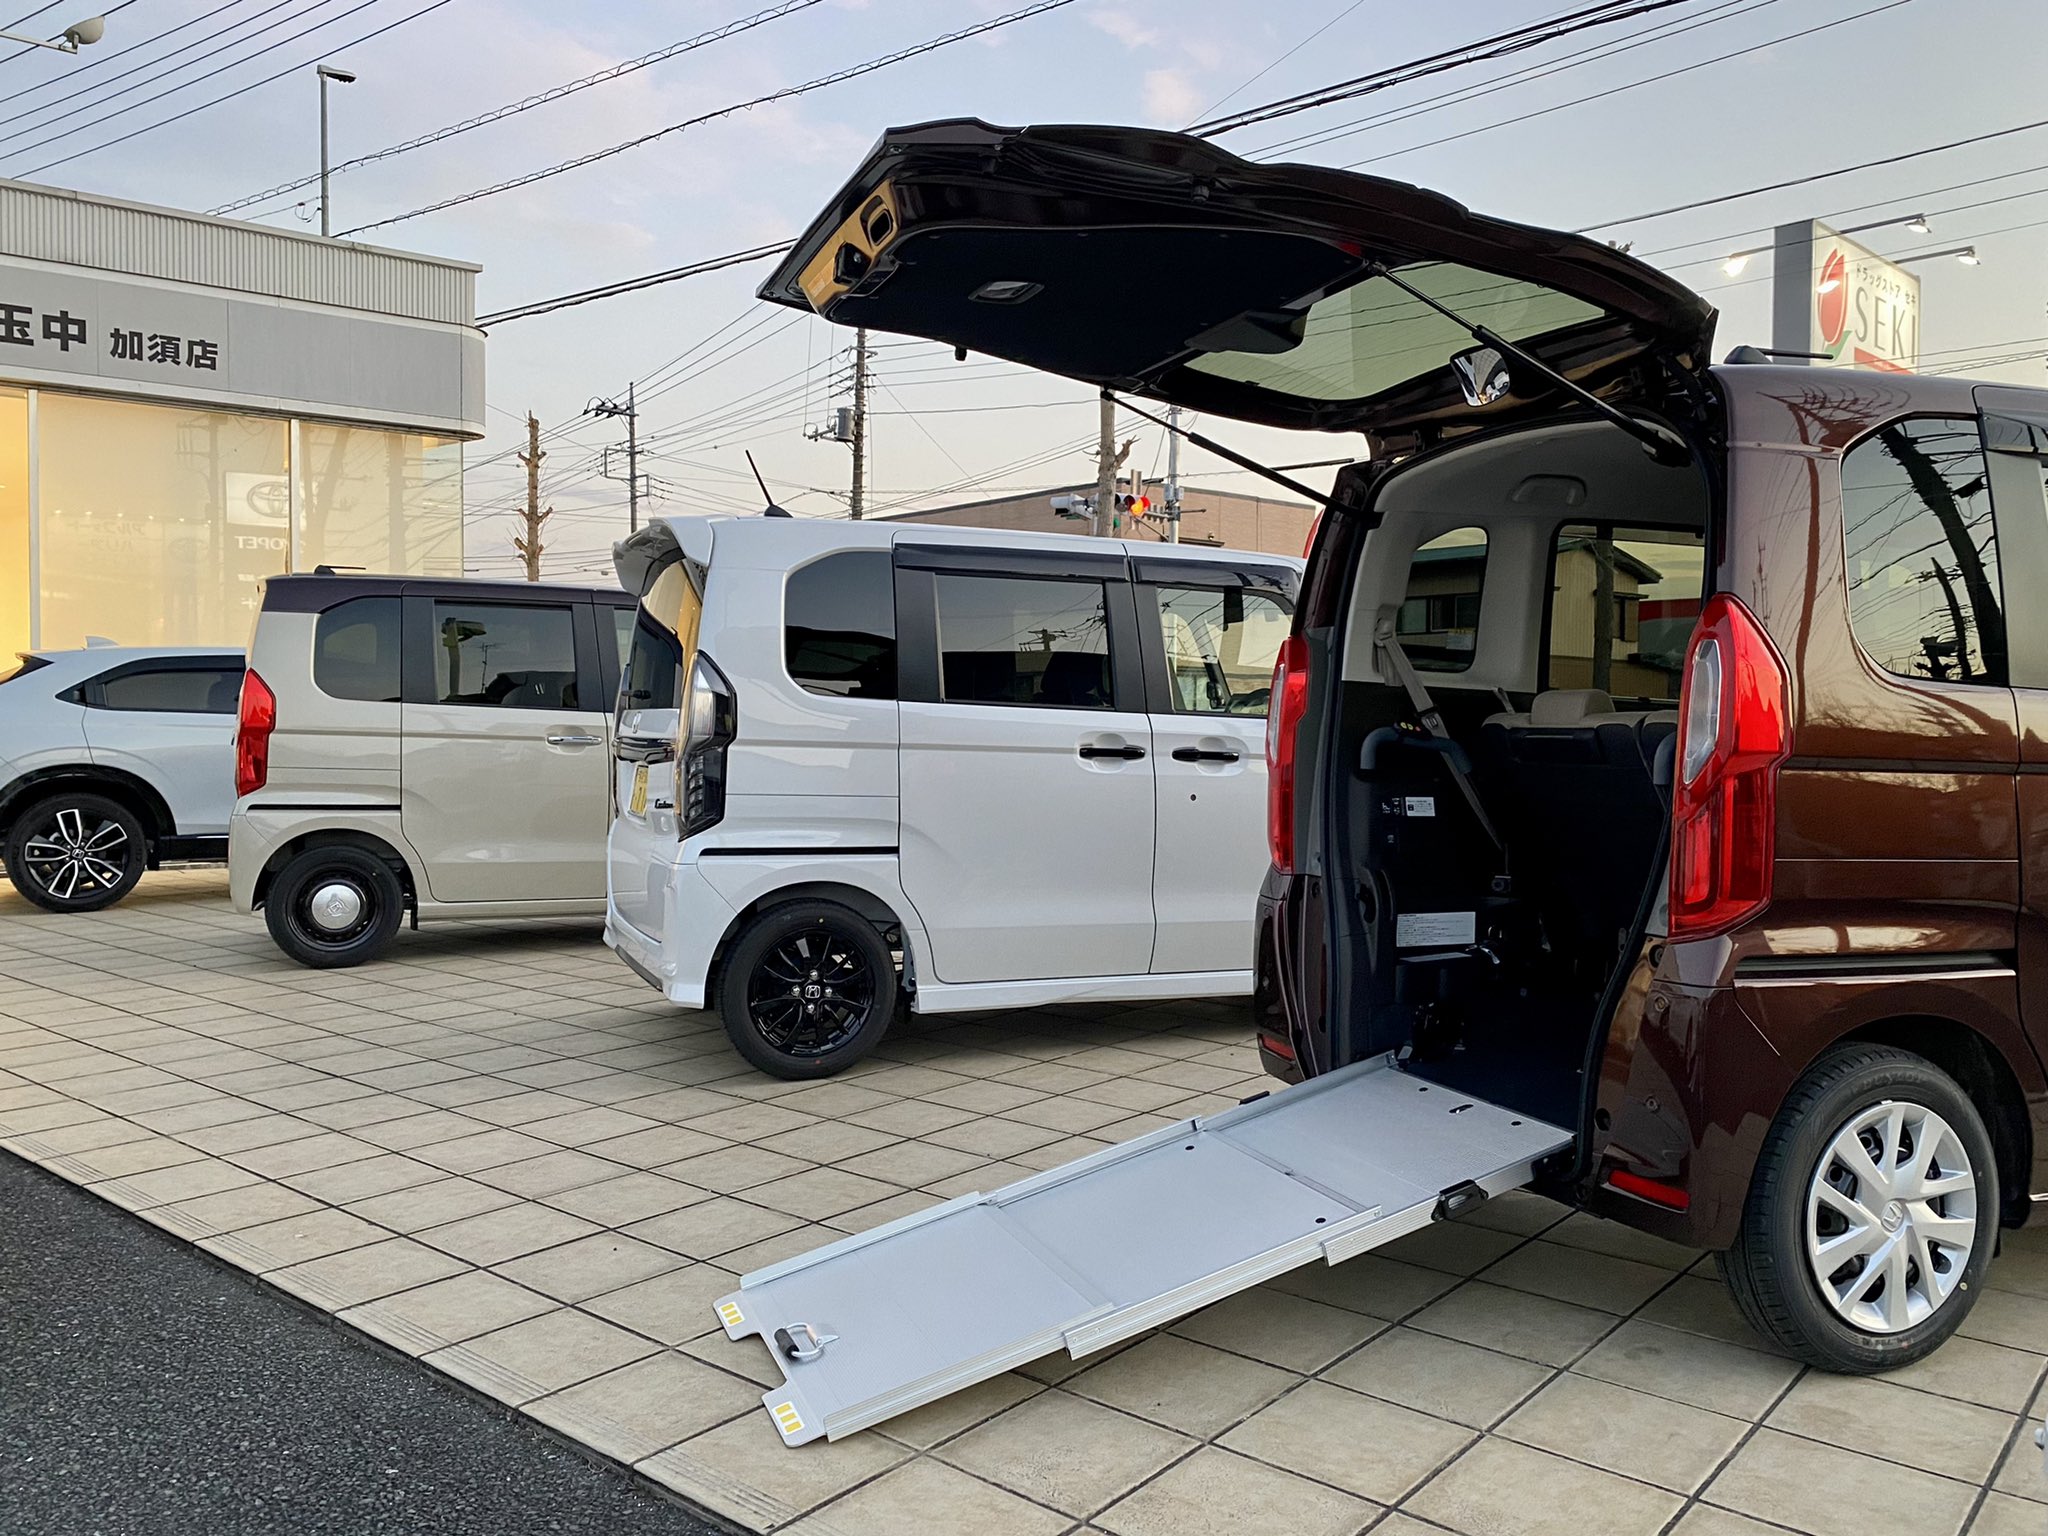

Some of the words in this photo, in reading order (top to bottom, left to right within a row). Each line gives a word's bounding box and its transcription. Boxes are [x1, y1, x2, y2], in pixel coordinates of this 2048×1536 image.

[109, 327, 219, 371] 加須店
[1855, 286, 1916, 365] SEKI
